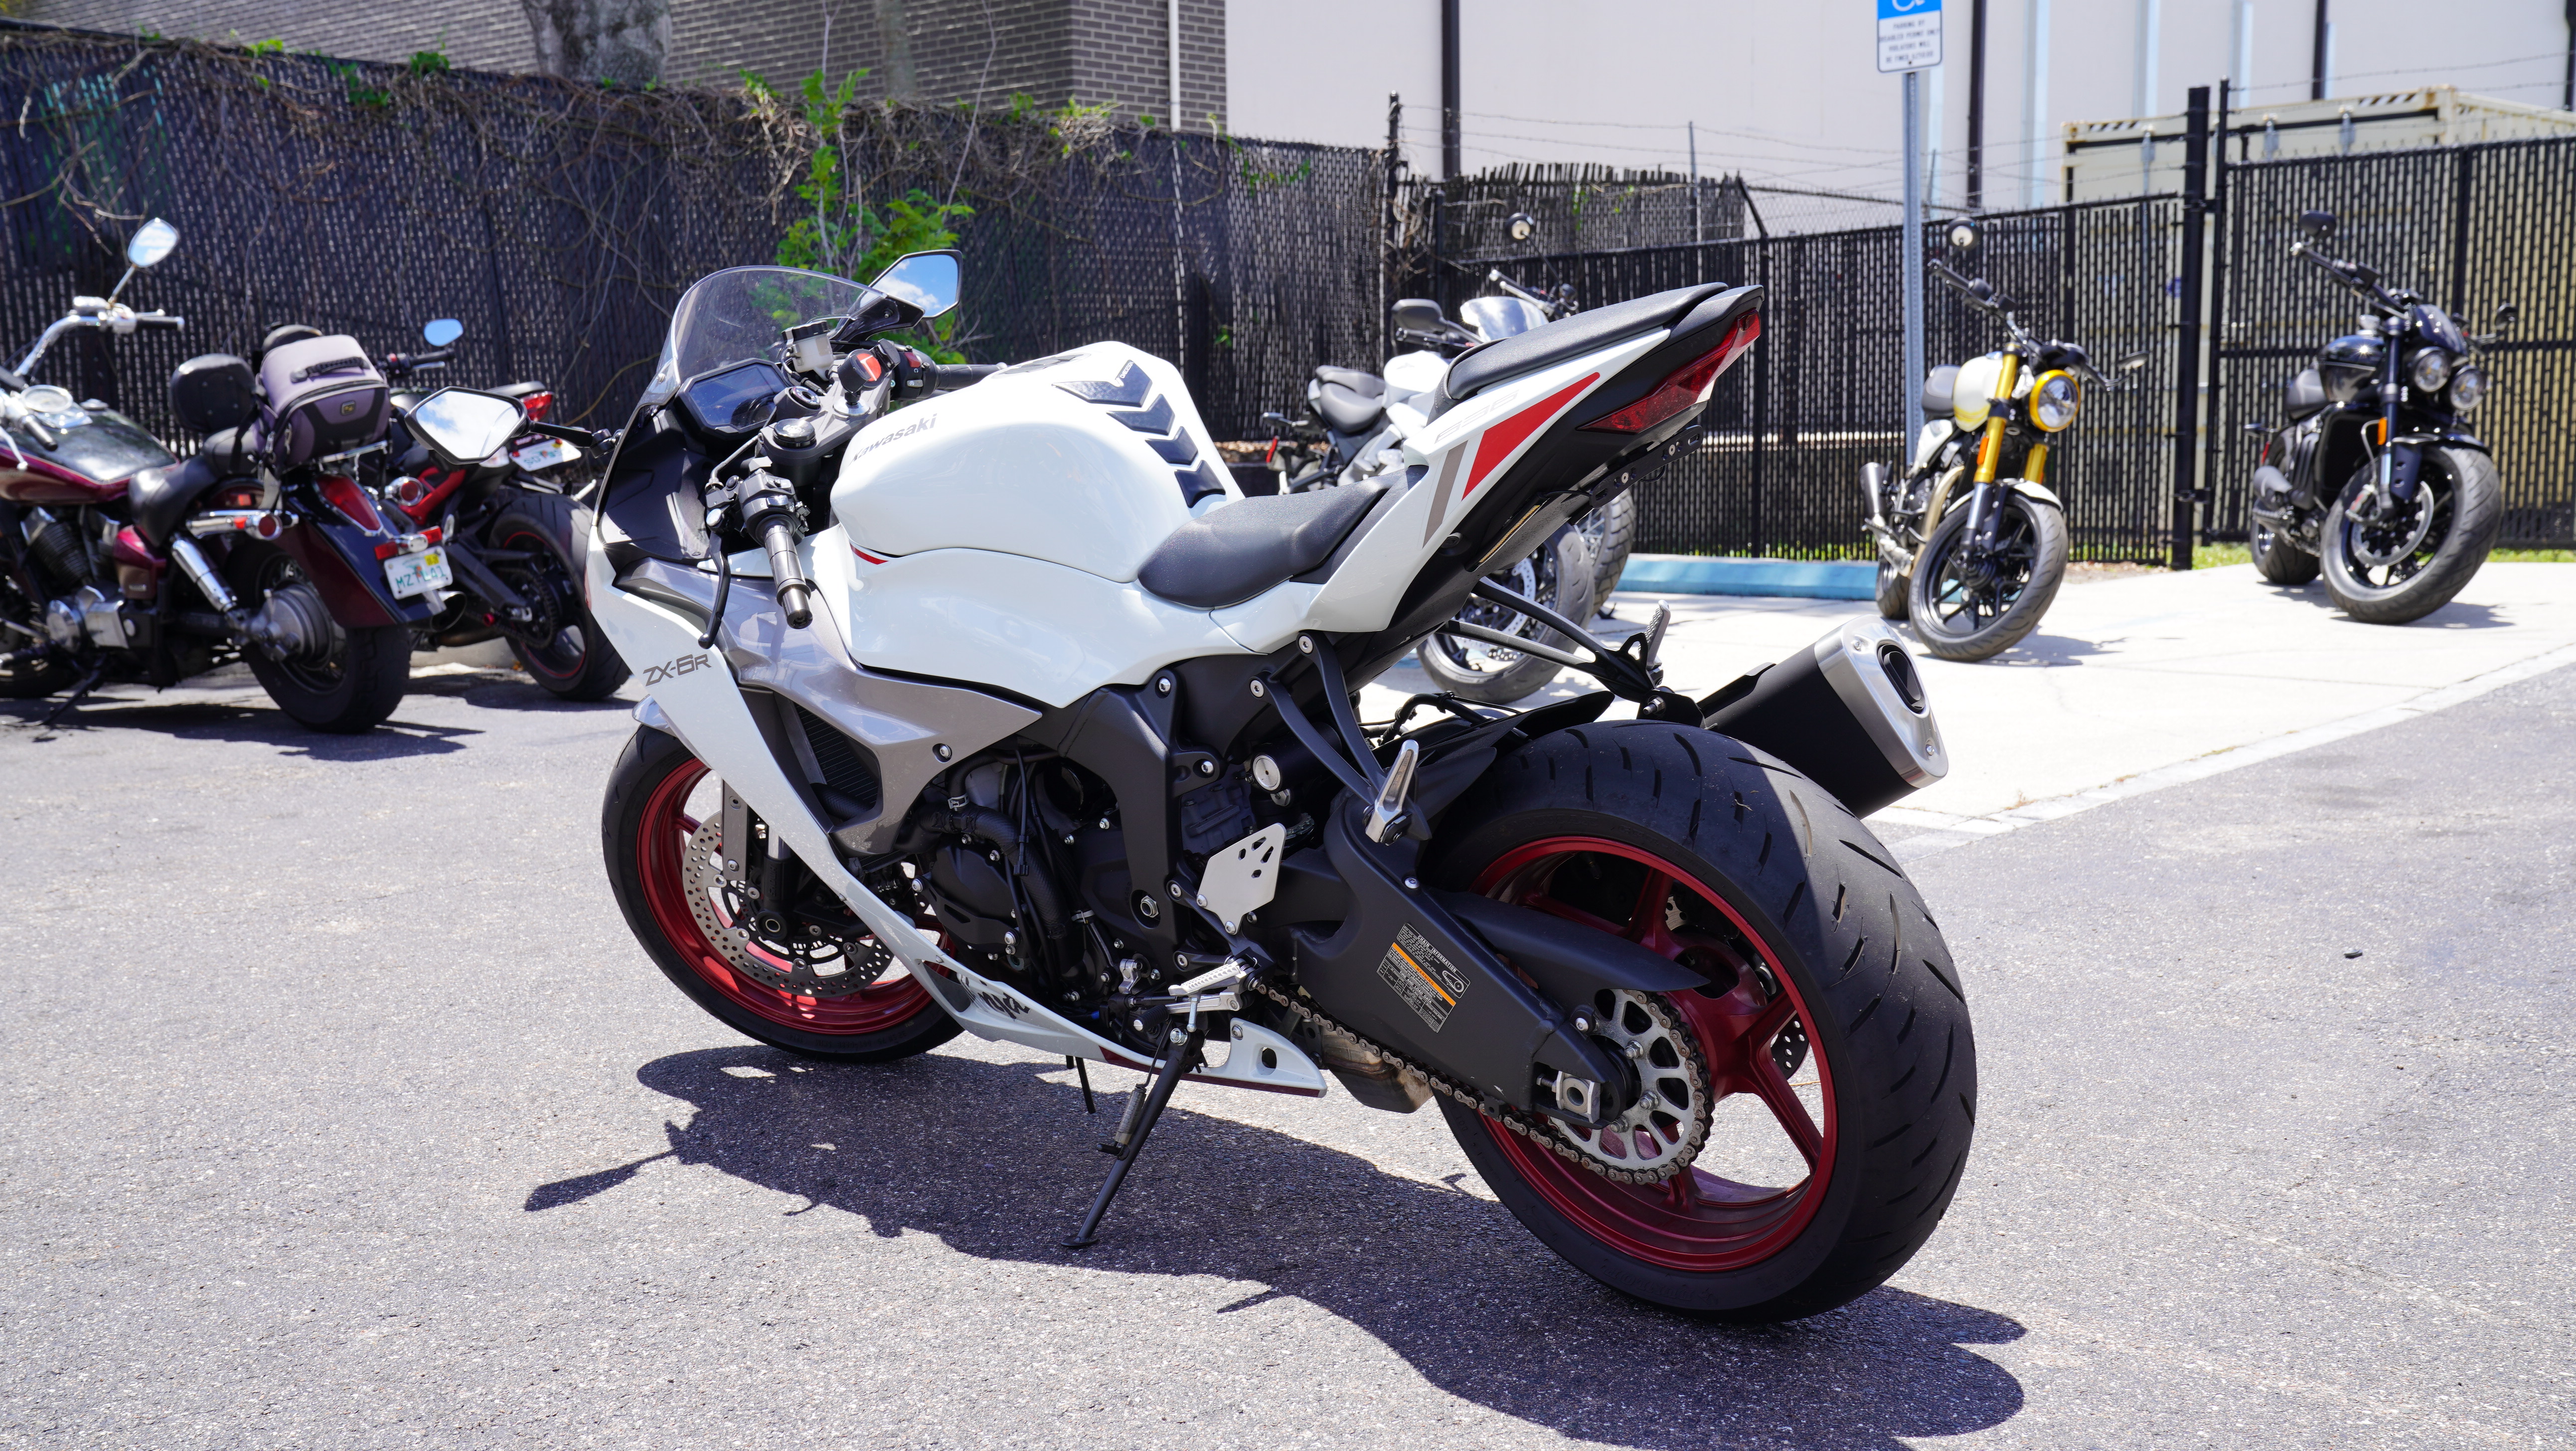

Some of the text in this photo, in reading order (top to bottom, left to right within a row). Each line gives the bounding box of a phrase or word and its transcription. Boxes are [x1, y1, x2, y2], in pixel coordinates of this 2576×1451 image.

[849, 413, 937, 465] Kawasaki
[643, 654, 711, 686] ZX-6R
[1417, 934, 1430, 947] CHAIN
[1431, 947, 1457, 972] INFORMATION
[1415, 966, 1435, 986] WARNING
[1414, 985, 1424, 996] LOAD
[1423, 994, 1432, 1004] DATA
